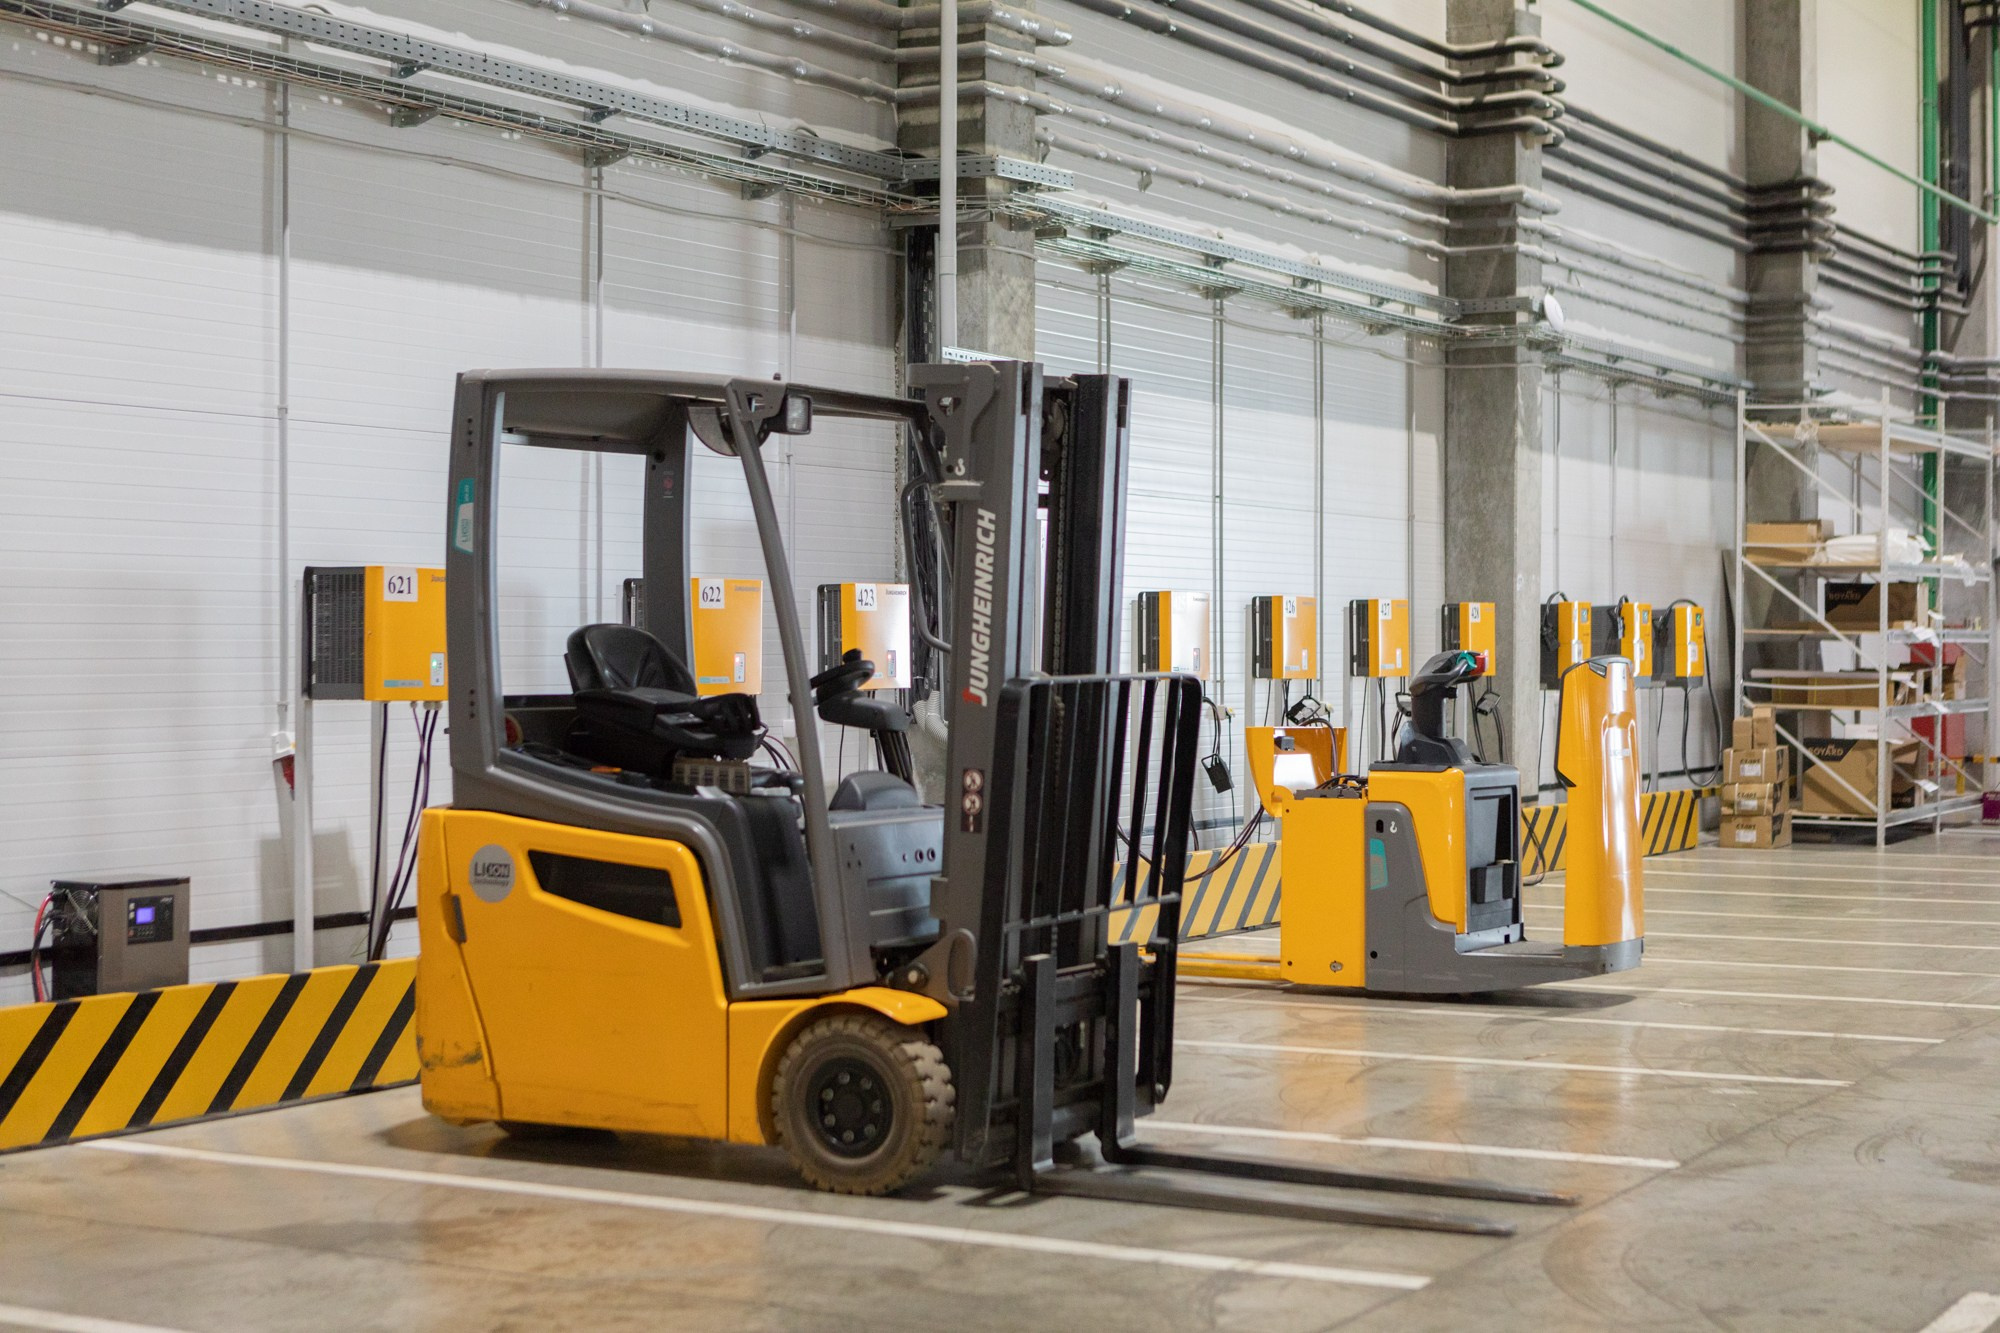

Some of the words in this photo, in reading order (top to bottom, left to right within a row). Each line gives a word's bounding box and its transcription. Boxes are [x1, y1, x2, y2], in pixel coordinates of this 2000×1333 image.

[388, 575, 412, 595] 621
[702, 586, 721, 603] 622
[858, 588, 875, 606] 423
[962, 508, 997, 707] JUNGHEINRICH
[1284, 599, 1296, 615] 426
